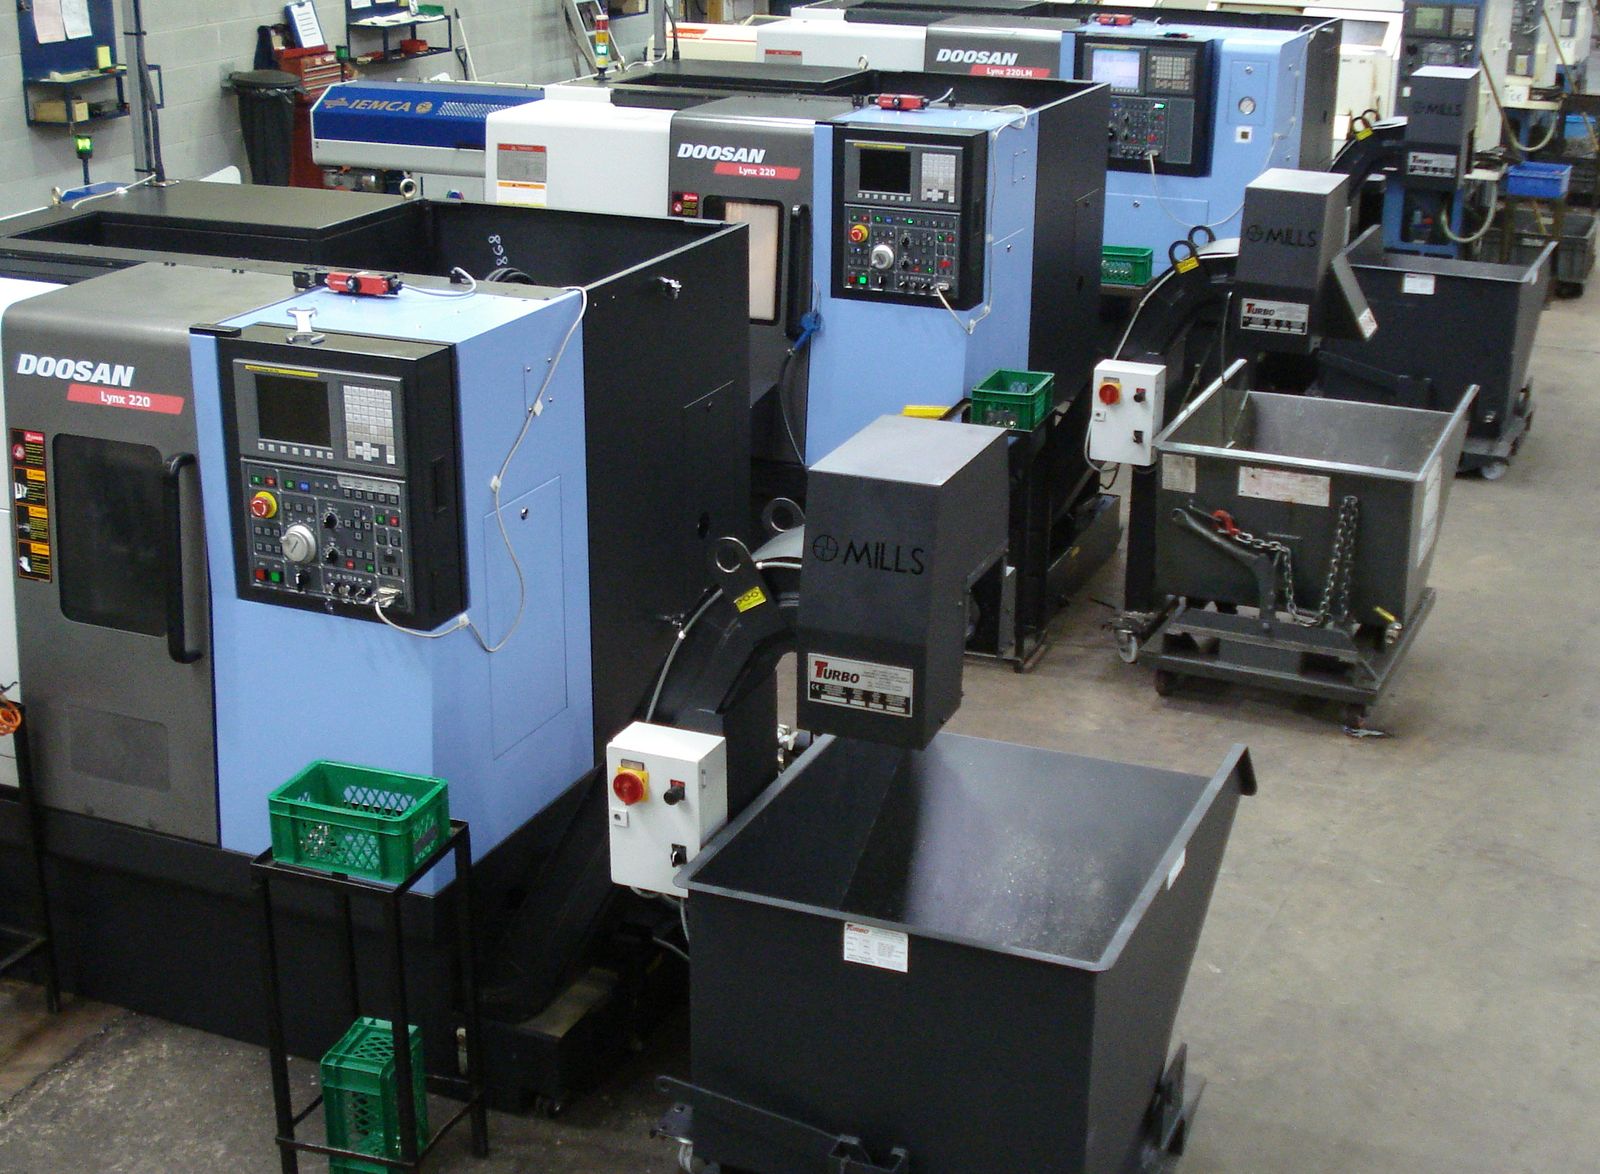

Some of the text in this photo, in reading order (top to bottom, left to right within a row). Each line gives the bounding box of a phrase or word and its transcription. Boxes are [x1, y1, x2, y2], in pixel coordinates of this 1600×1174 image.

[936, 48, 1018, 66] DOOSAN
[986, 67, 1004, 77] Lynx
[348, 99, 412, 112] IEMCA
[677, 143, 766, 164] DOOSAN
[738, 166, 776, 177] Lynx 220
[1266, 227, 1318, 248] MILLS
[16, 353, 135, 388] DOOSAN
[100, 391, 151, 408] Lynx 220
[843, 540, 924, 575] MILLS
[815, 660, 860, 684] TURBO
